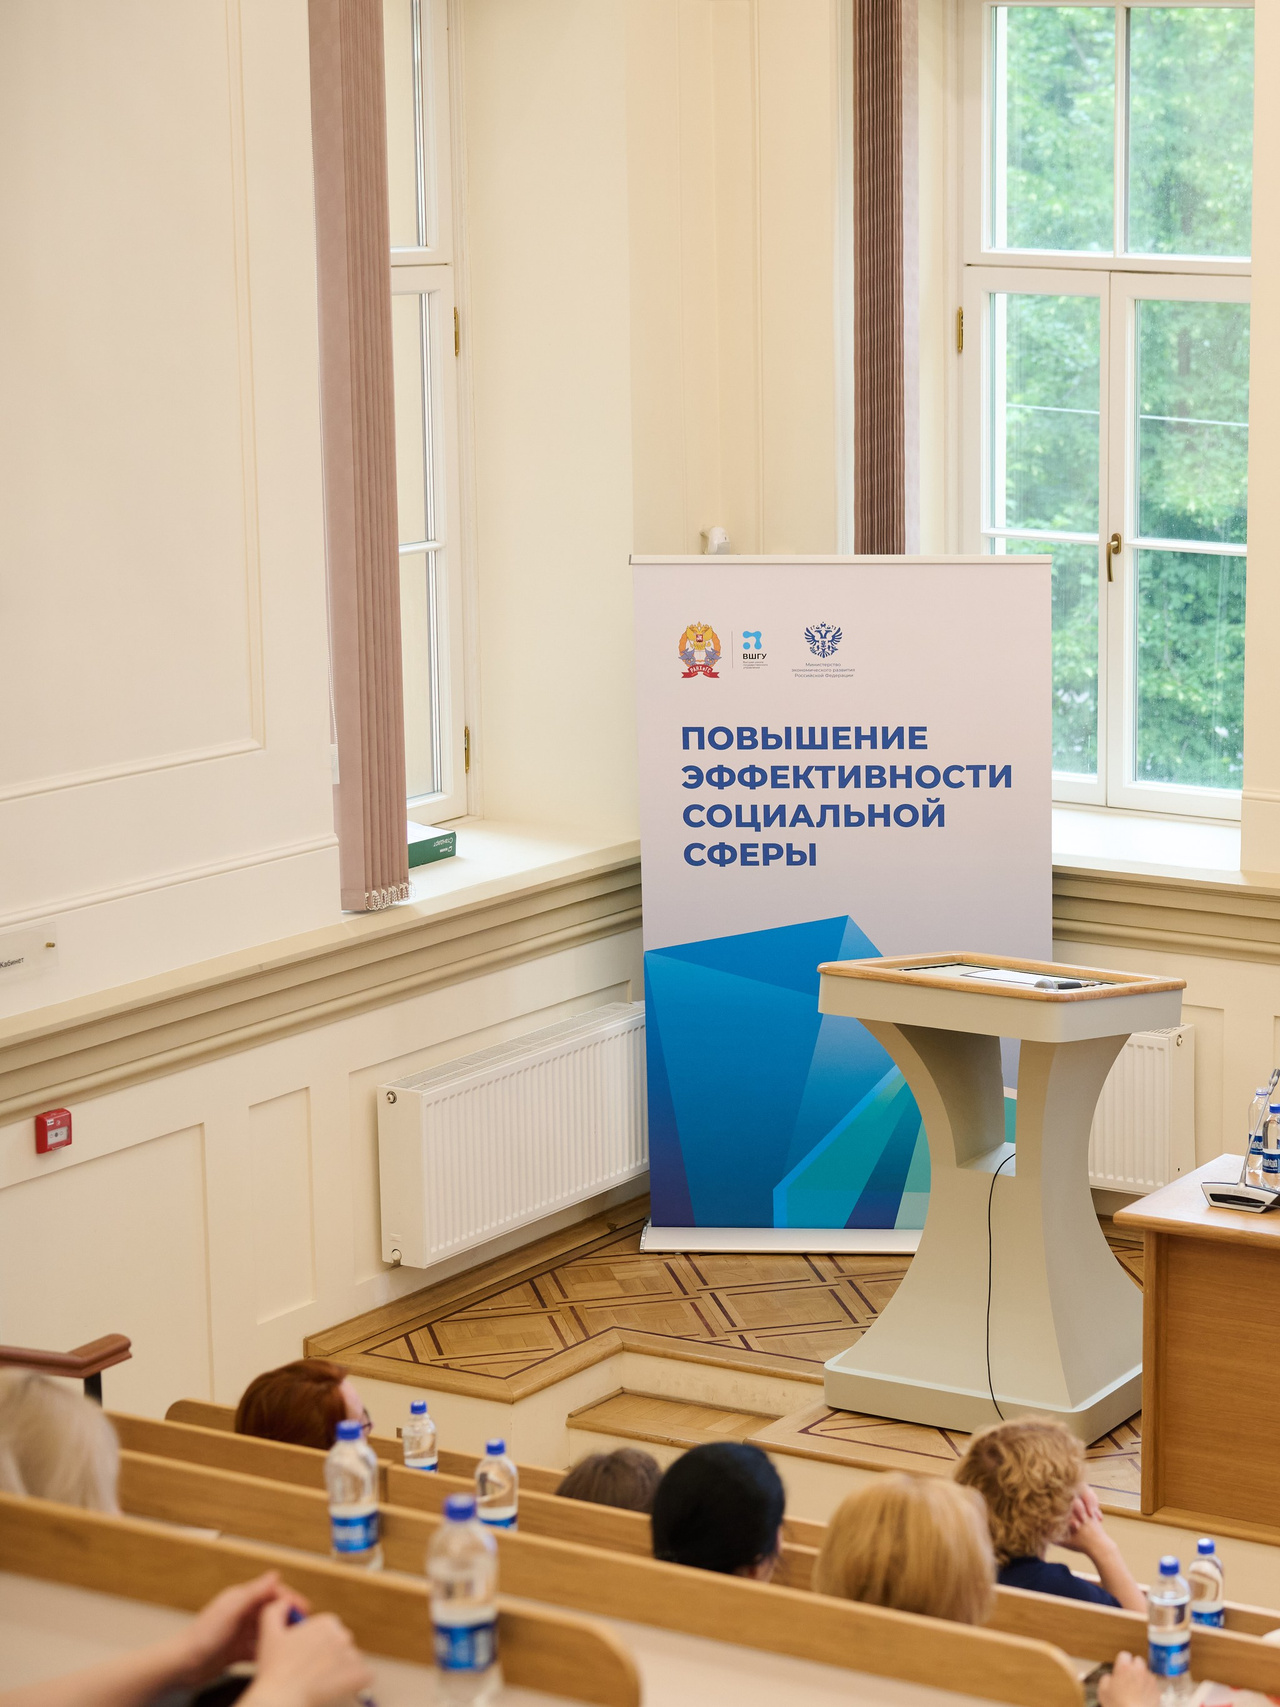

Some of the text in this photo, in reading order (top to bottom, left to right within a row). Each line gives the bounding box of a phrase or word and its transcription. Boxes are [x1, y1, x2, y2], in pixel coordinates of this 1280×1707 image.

[742, 652, 767, 660] ВШГУ
[681, 725, 928, 751] ПОВЫШЕНИЕ
[681, 764, 1012, 791] ЭФФЕКТИВНОСТИ
[682, 797, 945, 833] СОЦИАЛЬНОЙ
[683, 841, 817, 868] СФЕРЫ
